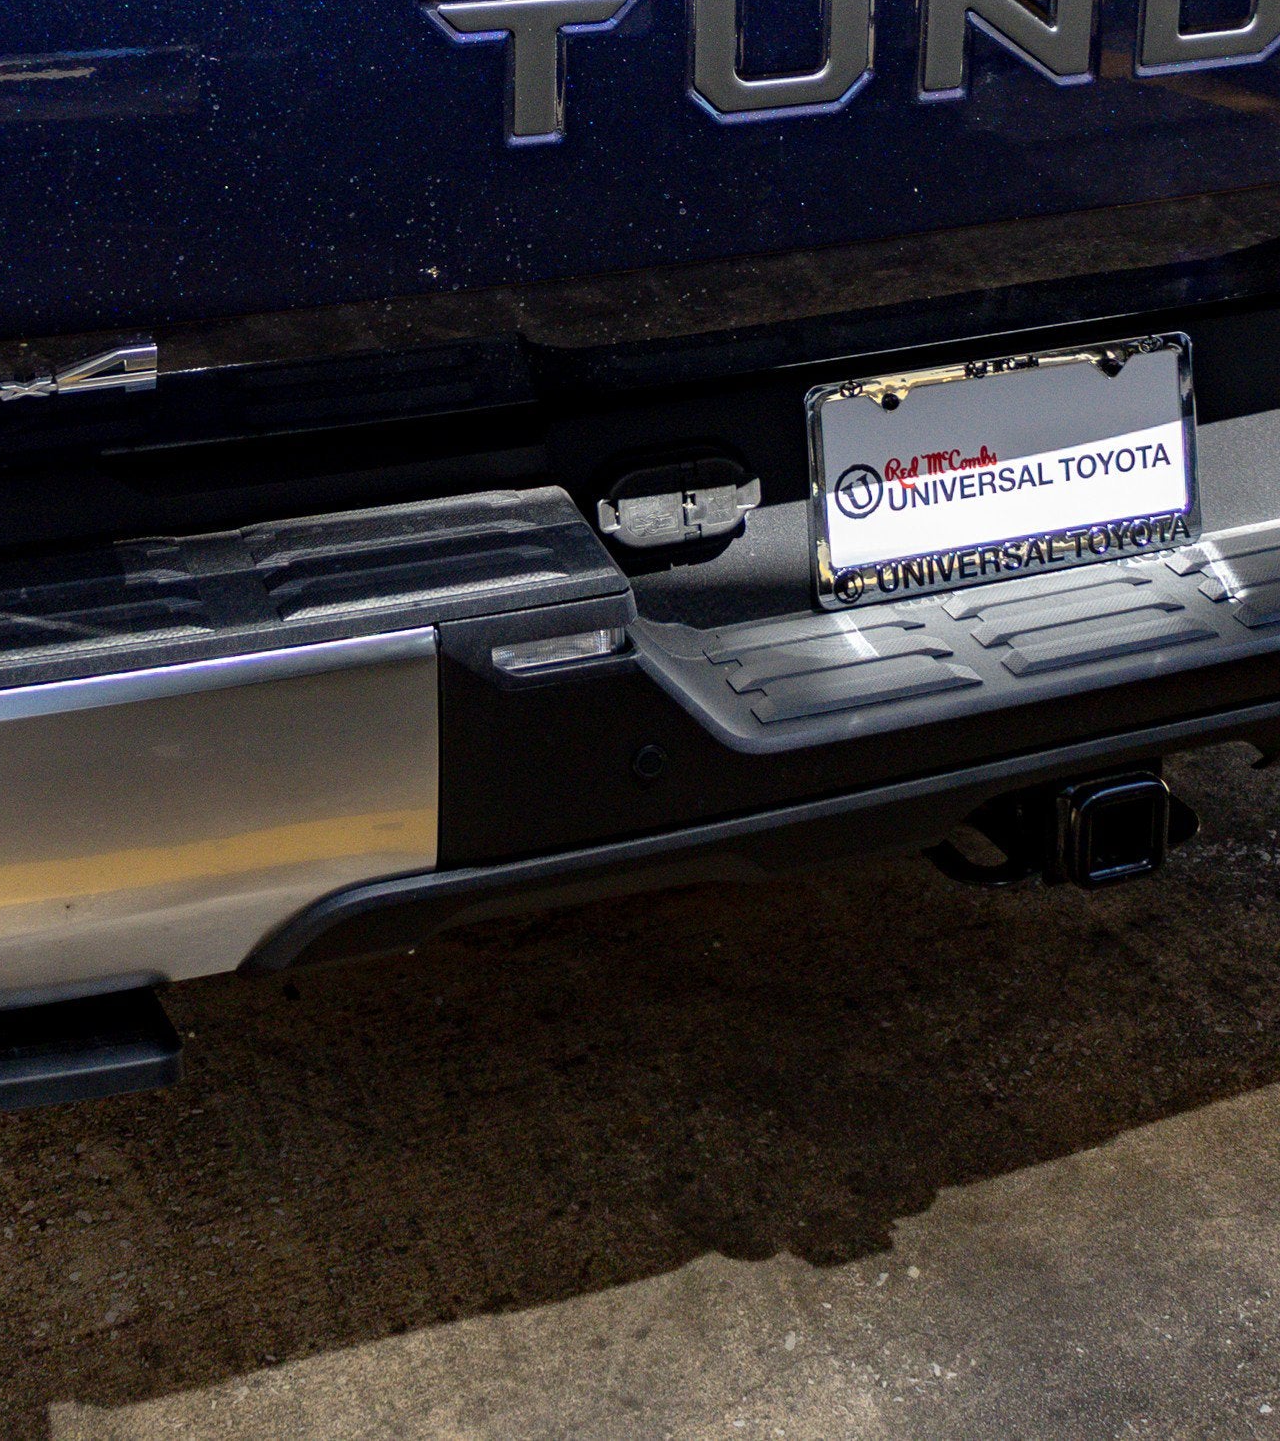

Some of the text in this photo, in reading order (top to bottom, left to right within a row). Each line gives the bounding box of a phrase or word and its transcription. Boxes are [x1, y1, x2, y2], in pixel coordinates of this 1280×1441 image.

[884, 445, 998, 489] Red McCombs
[887, 442, 1171, 511] UNIVERSAL TOYOTA
[876, 534, 1065, 594] UNIVERSAL
[1066, 512, 1192, 558] TOYOTA
